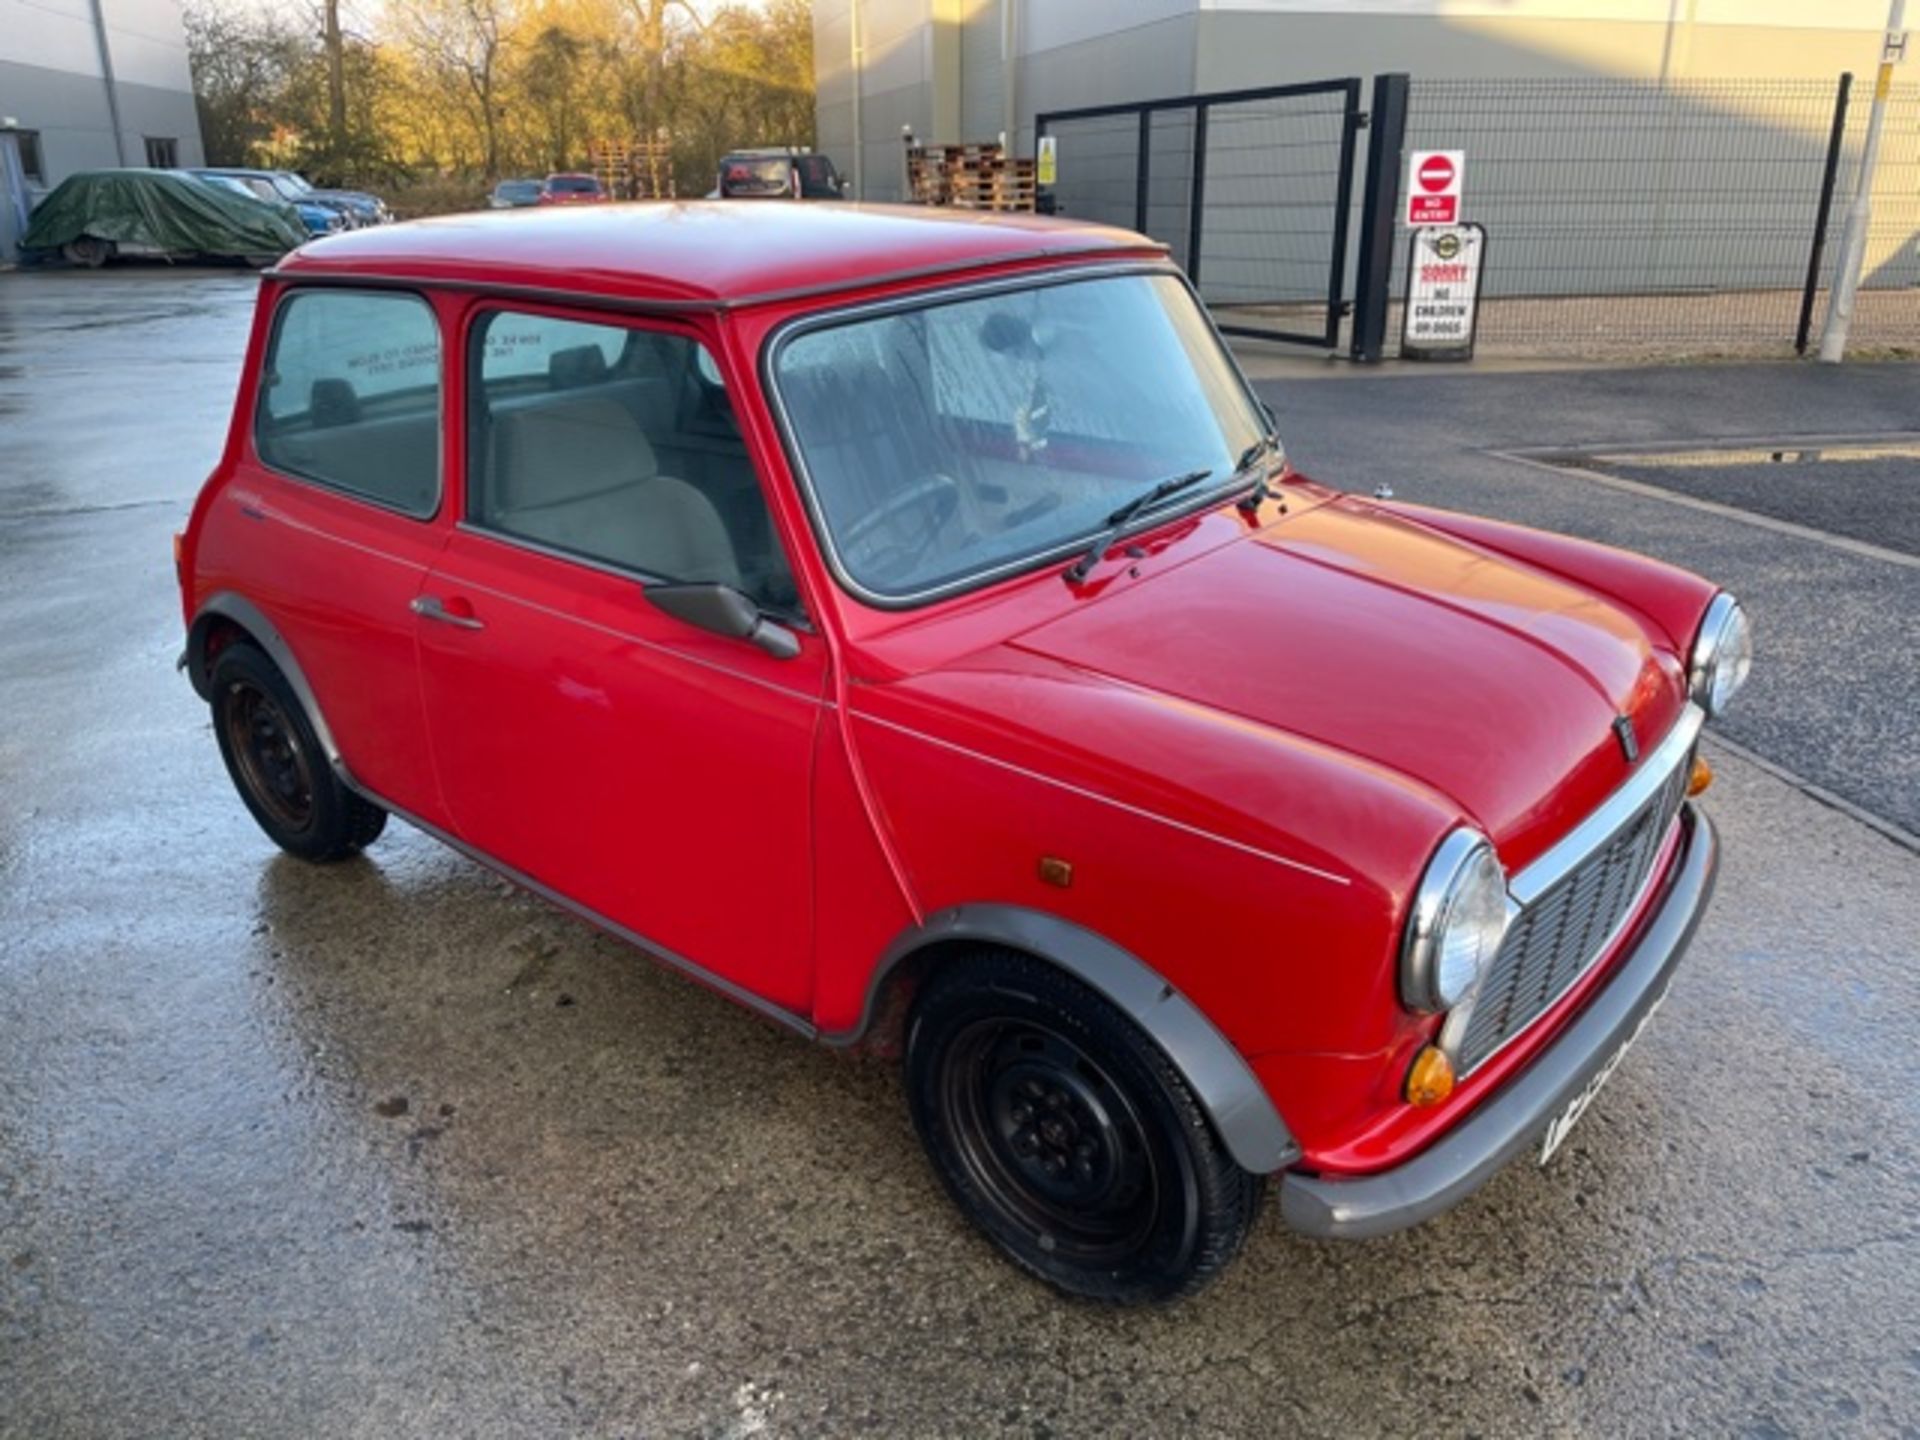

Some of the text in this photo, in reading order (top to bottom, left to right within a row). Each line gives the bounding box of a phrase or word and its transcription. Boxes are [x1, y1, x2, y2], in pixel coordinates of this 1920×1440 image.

[1883, 32, 1908, 60] H
[1424, 197, 1443, 208] NO
[1412, 209, 1450, 220] ENTRY
[1421, 264, 1468, 282] SORRY
[1416, 305, 1467, 317] CHILDREN
[1433, 320, 1462, 334] DOGS
